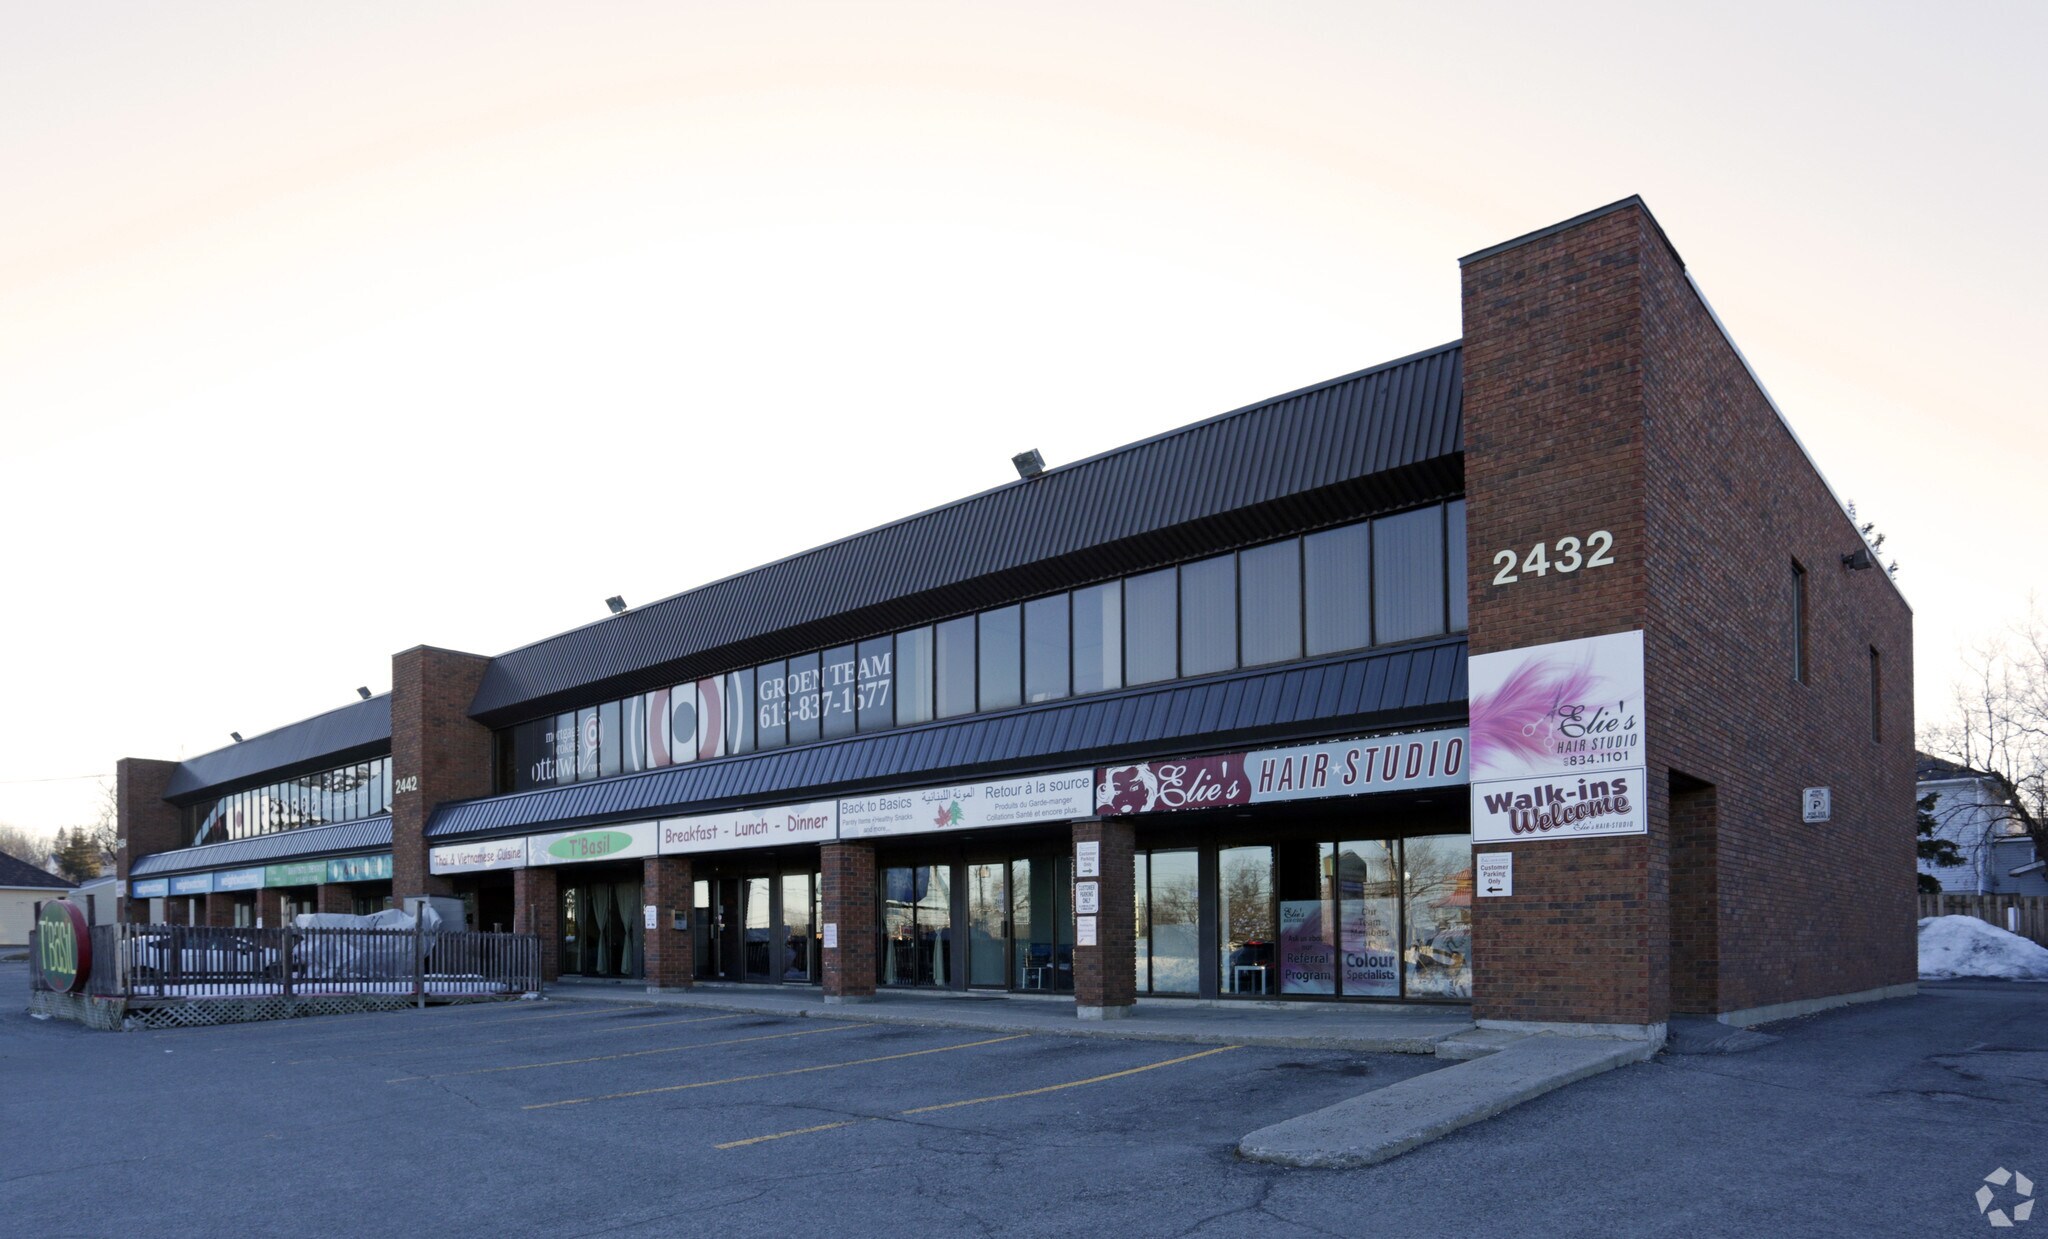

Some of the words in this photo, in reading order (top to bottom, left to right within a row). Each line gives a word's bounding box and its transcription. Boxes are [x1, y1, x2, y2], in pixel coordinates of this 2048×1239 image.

[1492, 530, 1615, 585] 2432
[760, 667, 825, 701] GROEN
[830, 652, 892, 686] TEAM
[760, 679, 891, 729] 613-837-1677
[1557, 700, 1637, 738] Elie's
[1557, 739, 1586, 754] HAIR
[1591, 733, 1637, 751] STUDIO
[1569, 751, 1628, 766] 834.1101
[1158, 761, 1241, 807] Elie's
[1257, 753, 1329, 794] HAIR
[1342, 737, 1464, 786] STUDIO
[395, 775, 418, 794] 2442
[985, 784, 1022, 799] Retour
[1025, 782, 1032, 794] à
[1036, 781, 1046, 793] la
[1049, 777, 1090, 792] source
[842, 801, 865, 814] Back
[867, 801, 877, 812] to
[879, 797, 912, 810] Basics
[994, 802, 1018, 810] Produits
[1484, 778, 1628, 815] Walk-ins
[1015, 811, 1033, 819] Santé
[1041, 808, 1063, 816] encore
[1509, 795, 1632, 835] Welcome
[665, 824, 718, 844] Breakfast
[735, 818, 768, 837] Lunch
[787, 815, 828, 832] Dinner
[569, 836, 611, 856] T'Basil
[434, 854, 449, 867] Thai
[457, 851, 495, 865] Vietnamese
[497, 848, 522, 860] Cuisine
[1287, 953, 1329, 964] Referral
[1346, 953, 1395, 968] Colour
[1285, 969, 1331, 983] Program
[1346, 969, 1396, 981] Specialists
